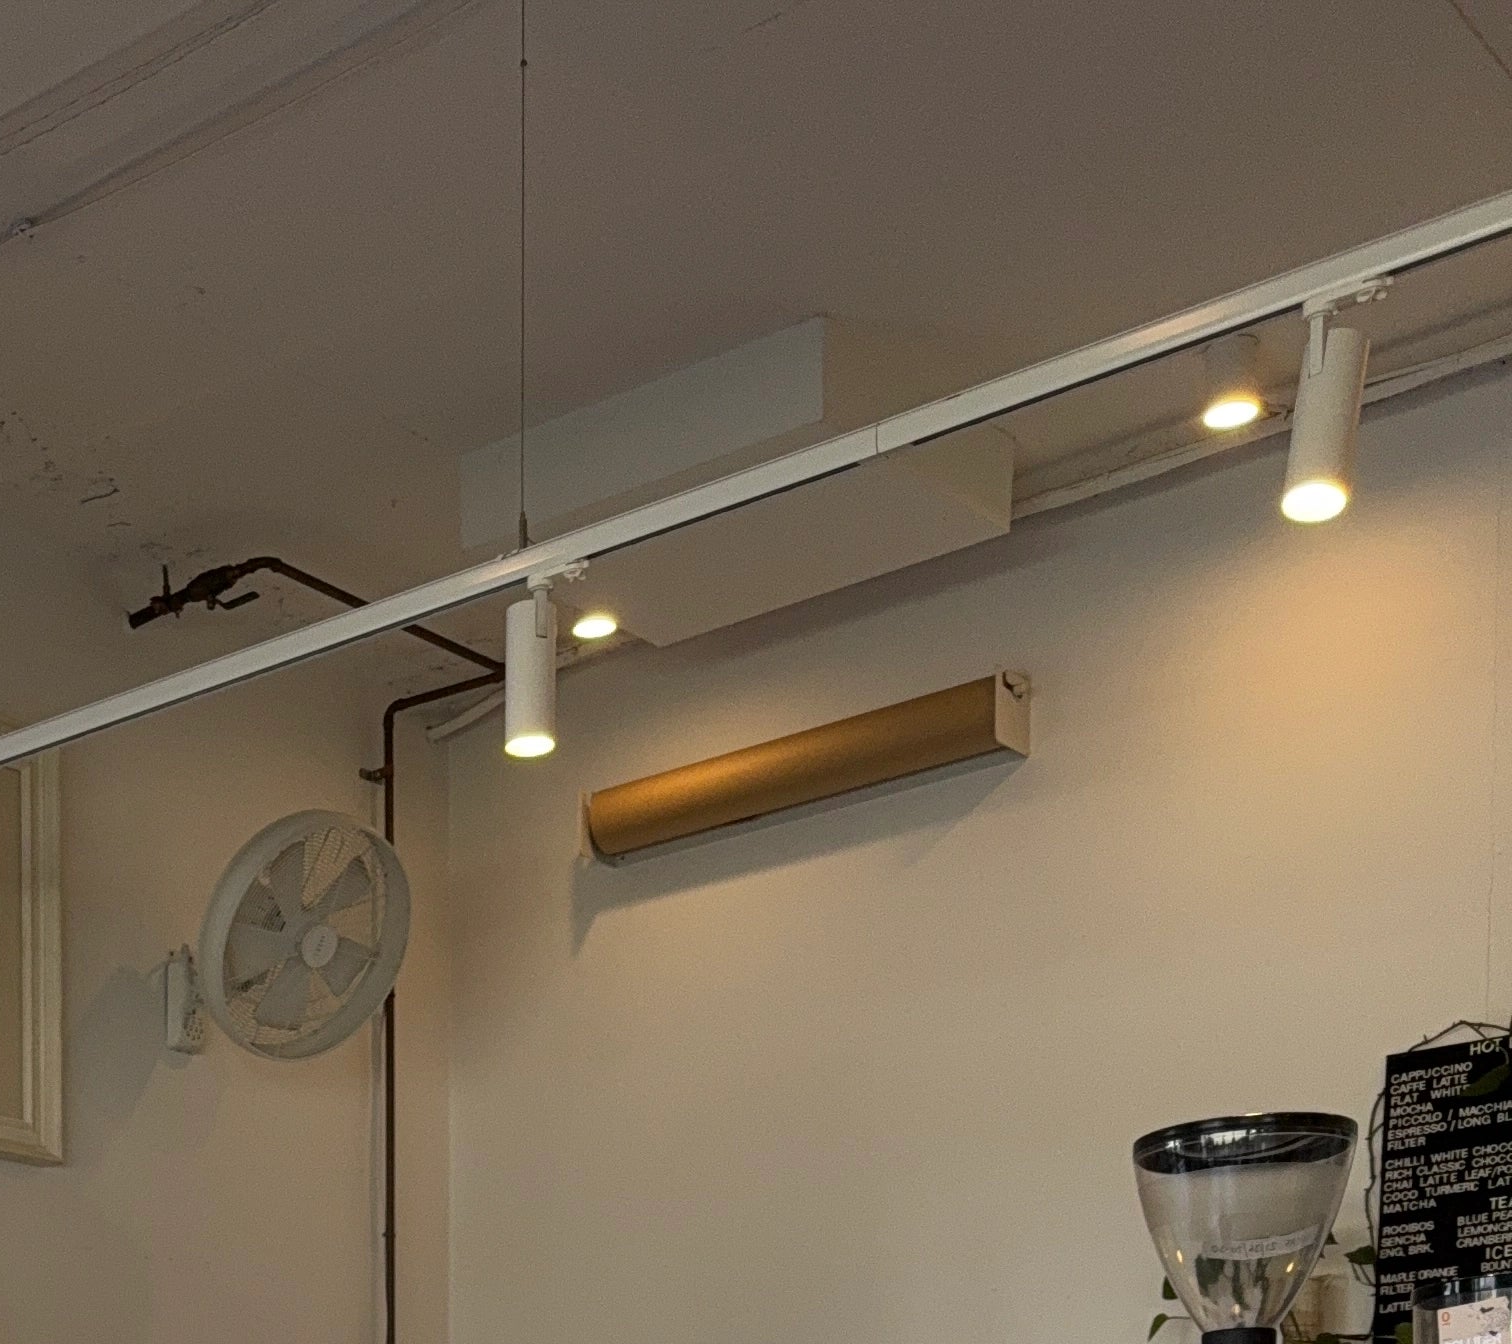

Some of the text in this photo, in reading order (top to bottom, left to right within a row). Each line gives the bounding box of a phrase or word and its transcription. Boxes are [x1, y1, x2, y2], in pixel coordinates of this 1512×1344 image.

[1470, 1038, 1503, 1056] HOT
[1391, 1062, 1472, 1083] CAPPUCCINO
[1390, 1074, 1468, 1094] CAFFE LATTE
[1390, 1093, 1419, 1106] FLAT
[1390, 1102, 1433, 1117] MOCHA
[1389, 1112, 1442, 1128] PICCOLO
[1388, 1122, 1447, 1140] ESPRESSO
[1387, 1136, 1426, 1151] FILTER
[1385, 1155, 1424, 1170] CHILLI
[1430, 1148, 1468, 1163] WHITE
[1385, 1168, 1412, 1180] RICH
[1416, 1160, 1466, 1176] CLASSIC
[1384, 1179, 1412, 1192] CHAI
[1419, 1172, 1458, 1187] LATTE
[1383, 1190, 1419, 1203] COCO
[1425, 1181, 1479, 1197] TURMERIC
[1383, 1199, 1437, 1214] MATCHA
[1382, 1221, 1435, 1236] ROOIBOS
[1457, 1212, 1488, 1226] BLUE
[1381, 1233, 1426, 1247] SENCHA
[1379, 1271, 1416, 1284] MAPLE
[1417, 1266, 1459, 1280] ORANGE
[1380, 1283, 1415, 1295] FILTER
